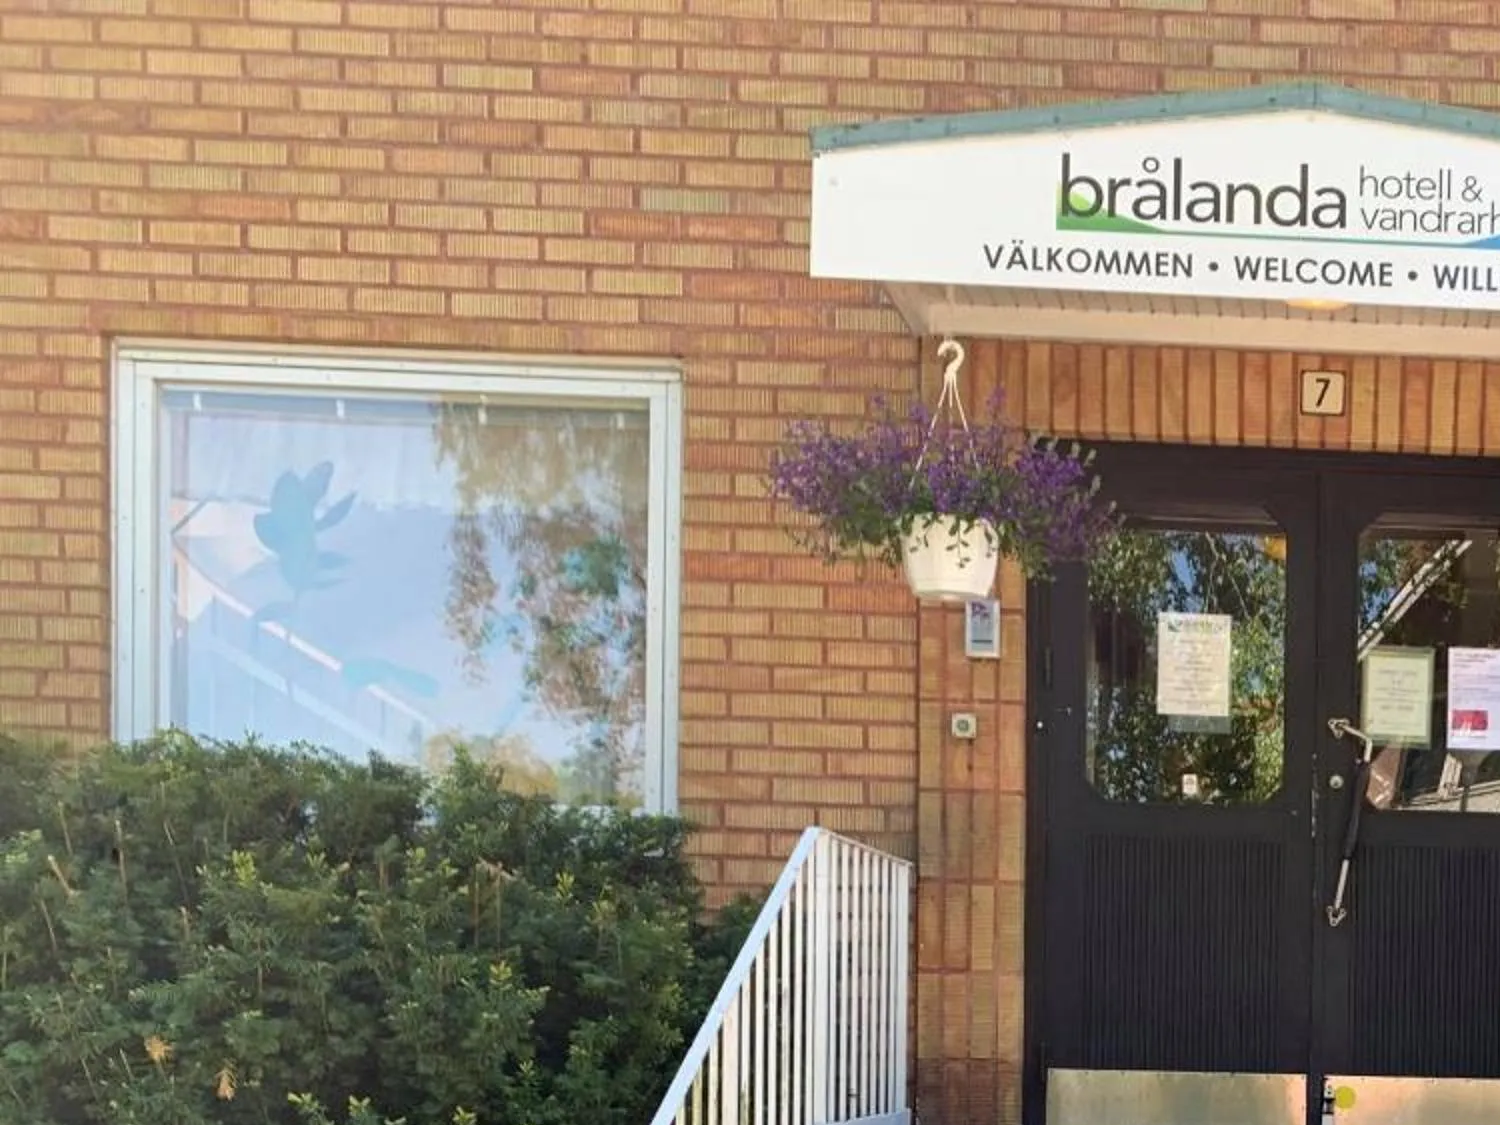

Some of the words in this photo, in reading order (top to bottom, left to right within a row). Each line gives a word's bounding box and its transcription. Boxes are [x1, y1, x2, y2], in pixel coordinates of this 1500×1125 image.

[1061, 152, 1348, 230] brålanda
[1359, 164, 1452, 201] hotell
[1461, 174, 1483, 202] &
[983, 240, 1194, 278] VÄLKOMMEN
[1234, 255, 1393, 288] WELCOME
[1314, 377, 1332, 408] 7
